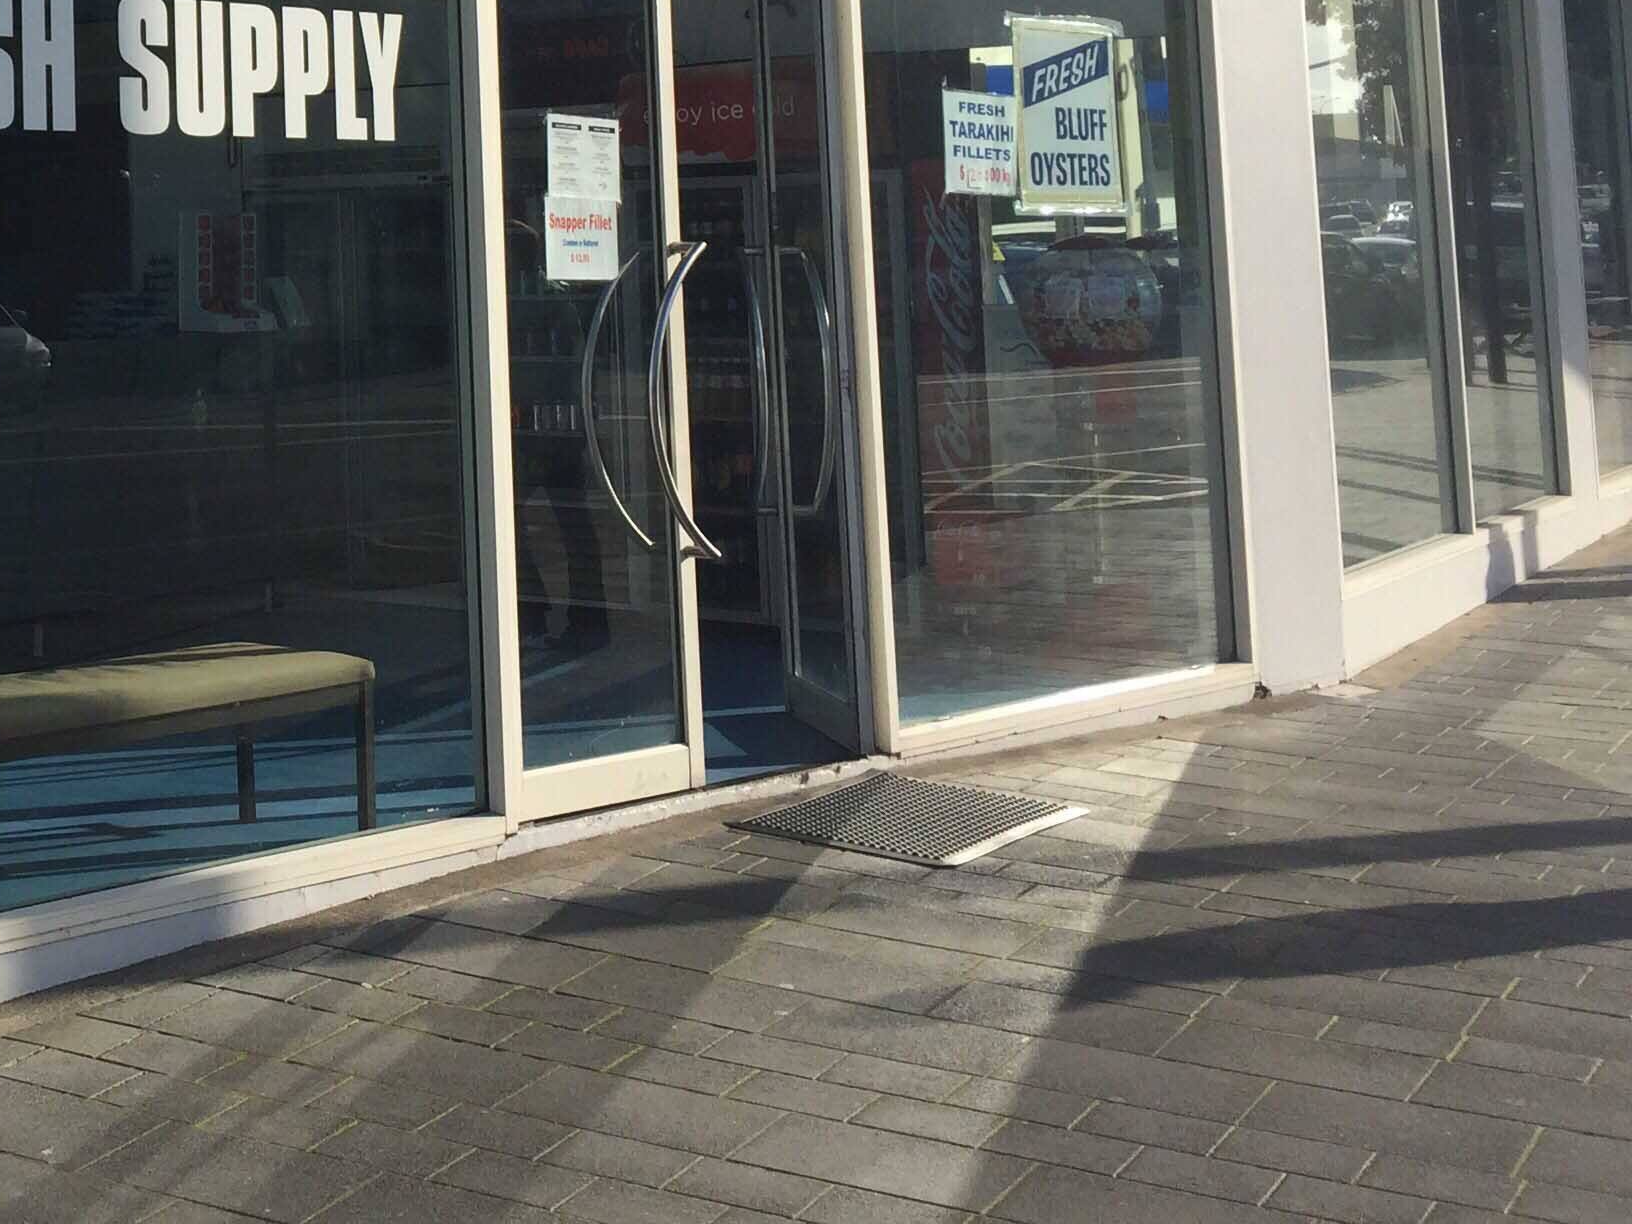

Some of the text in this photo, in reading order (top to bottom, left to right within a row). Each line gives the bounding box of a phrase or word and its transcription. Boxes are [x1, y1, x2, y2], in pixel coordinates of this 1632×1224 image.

[1032, 44, 1099, 103] FRESH
[711, 100, 744, 122] ice
[958, 101, 1006, 118] FRESH
[949, 120, 1014, 143] TARAKIHI
[1055, 107, 1107, 142] BLUFF
[953, 145, 1012, 162] FILLETS
[1030, 152, 1111, 188] OYSTERS
[549, 212, 586, 233] Snapper
